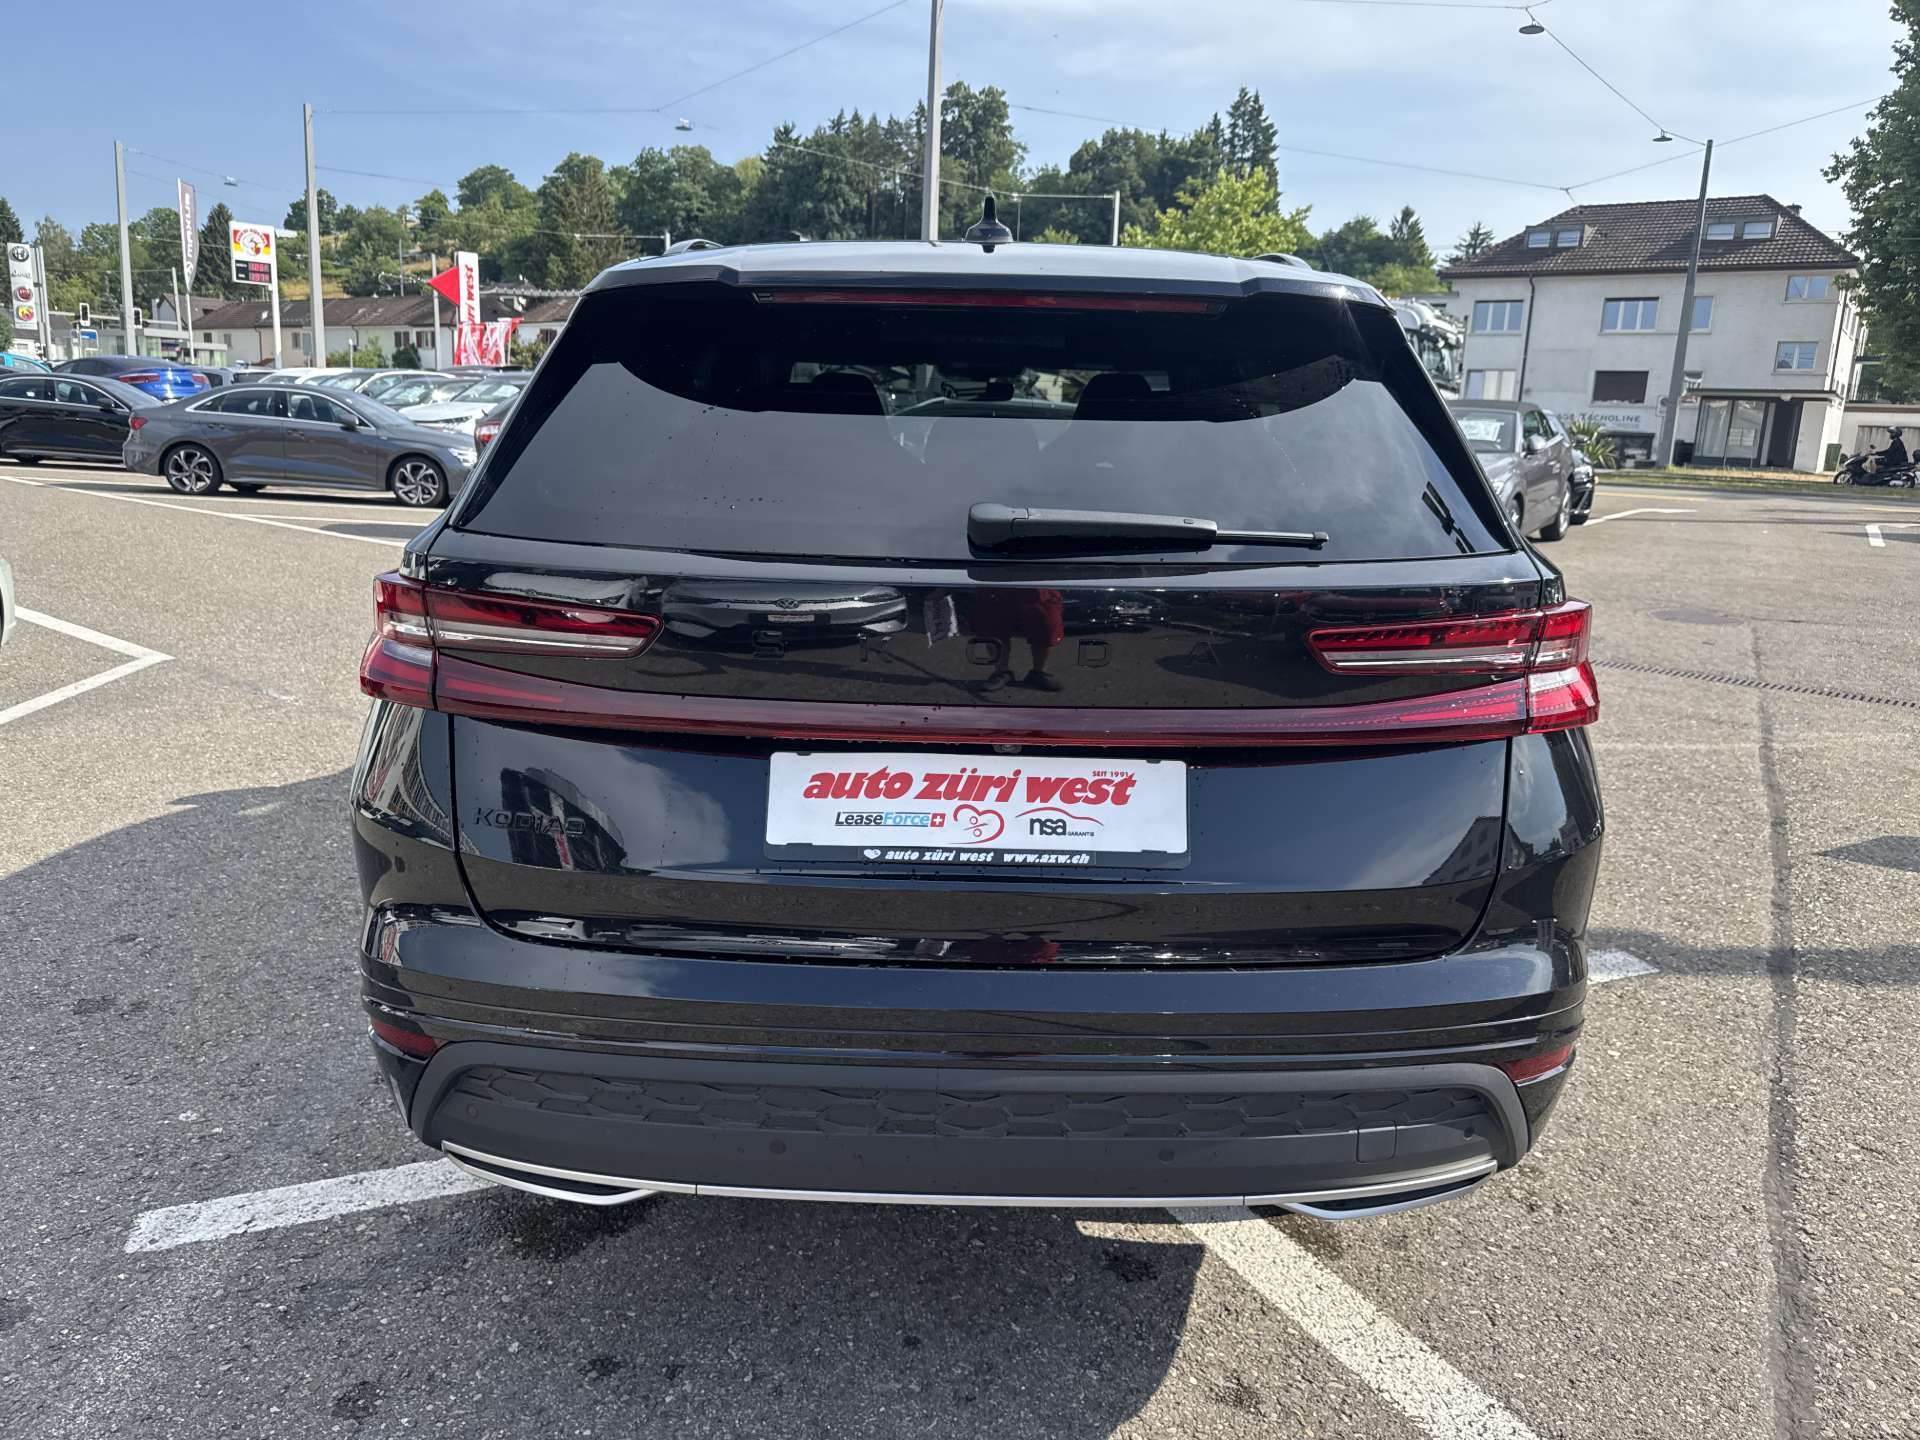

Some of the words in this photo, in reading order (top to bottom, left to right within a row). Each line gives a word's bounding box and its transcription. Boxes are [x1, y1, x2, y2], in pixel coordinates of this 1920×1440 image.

[803, 766, 914, 800] auto
[913, 767, 1022, 803] züri
[1026, 773, 1137, 806] west
[835, 811, 931, 826] LeaseForce
[1029, 818, 1067, 836] nsa
[885, 849, 920, 861] auto
[922, 849, 956, 861] züri
[959, 851, 994, 862] west
[1003, 853, 1090, 864] www.azw.ch
